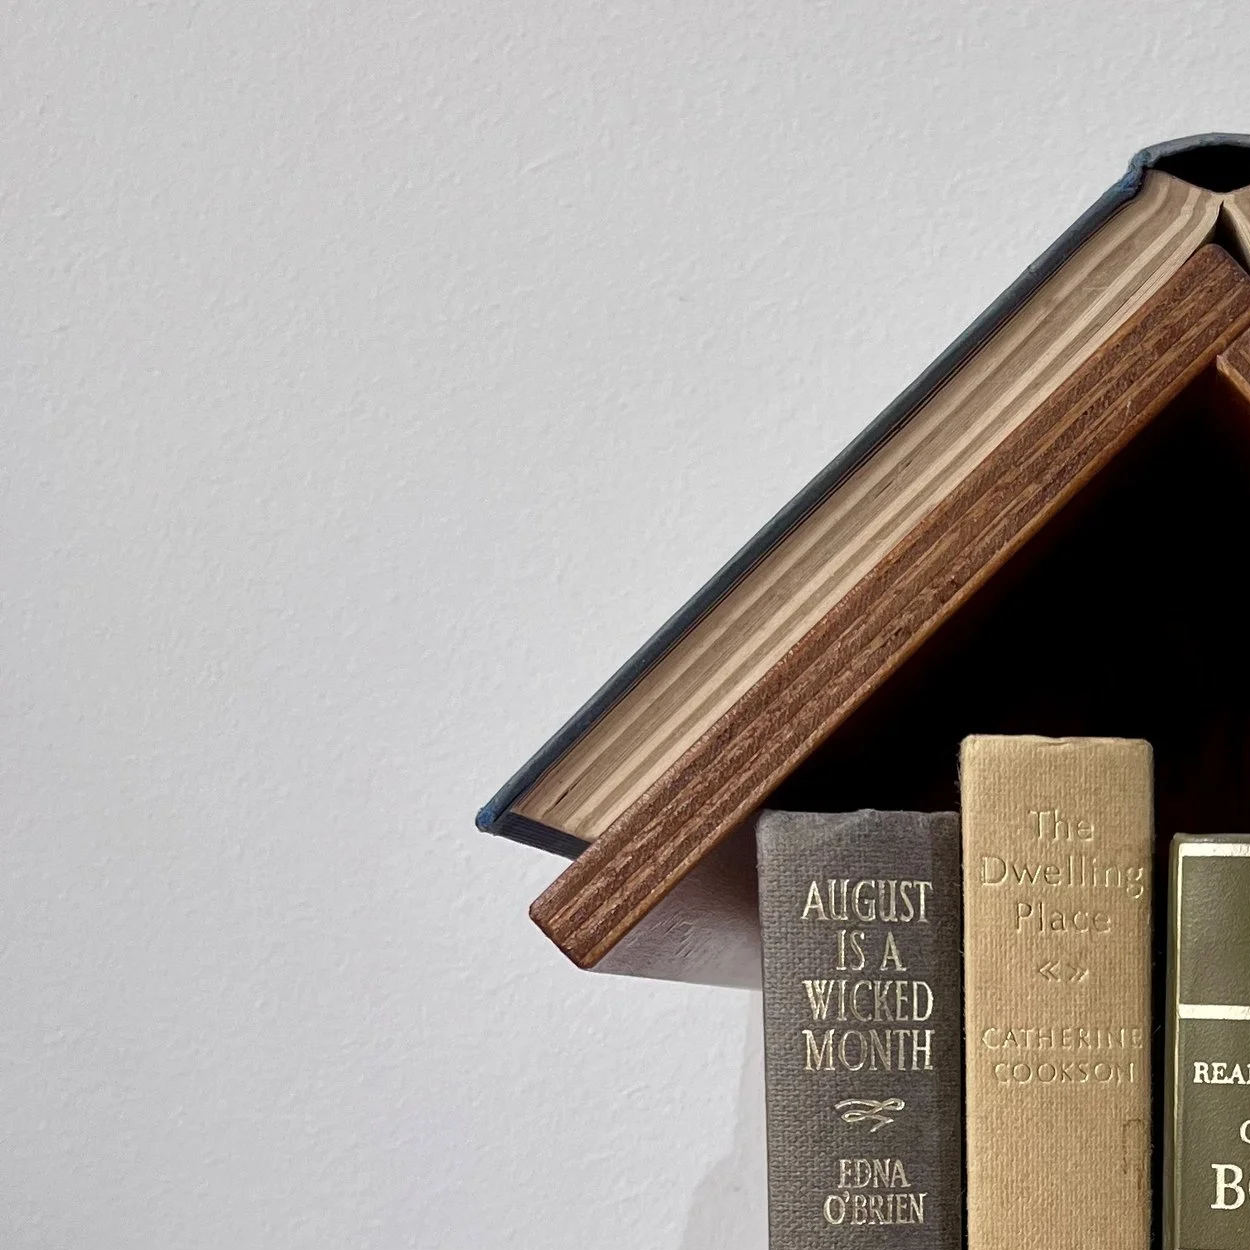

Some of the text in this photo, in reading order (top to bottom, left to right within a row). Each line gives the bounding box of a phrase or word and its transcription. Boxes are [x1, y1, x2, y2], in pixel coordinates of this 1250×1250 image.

[1029, 809, 1094, 842] The
[981, 855, 1144, 899] Dwelling
[801, 879, 933, 923] AUGUST
[1015, 902, 1112, 934] Place
[836, 930, 906, 971] IS A
[802, 980, 934, 1022] WICKED
[802, 1029, 934, 1072] MONTH
[981, 1027, 1143, 1050] CATHERINE
[994, 1062, 1135, 1085] COOKSON
[837, 1159, 911, 1189] EDNA
[823, 1192, 928, 1225] O'BRIEN
